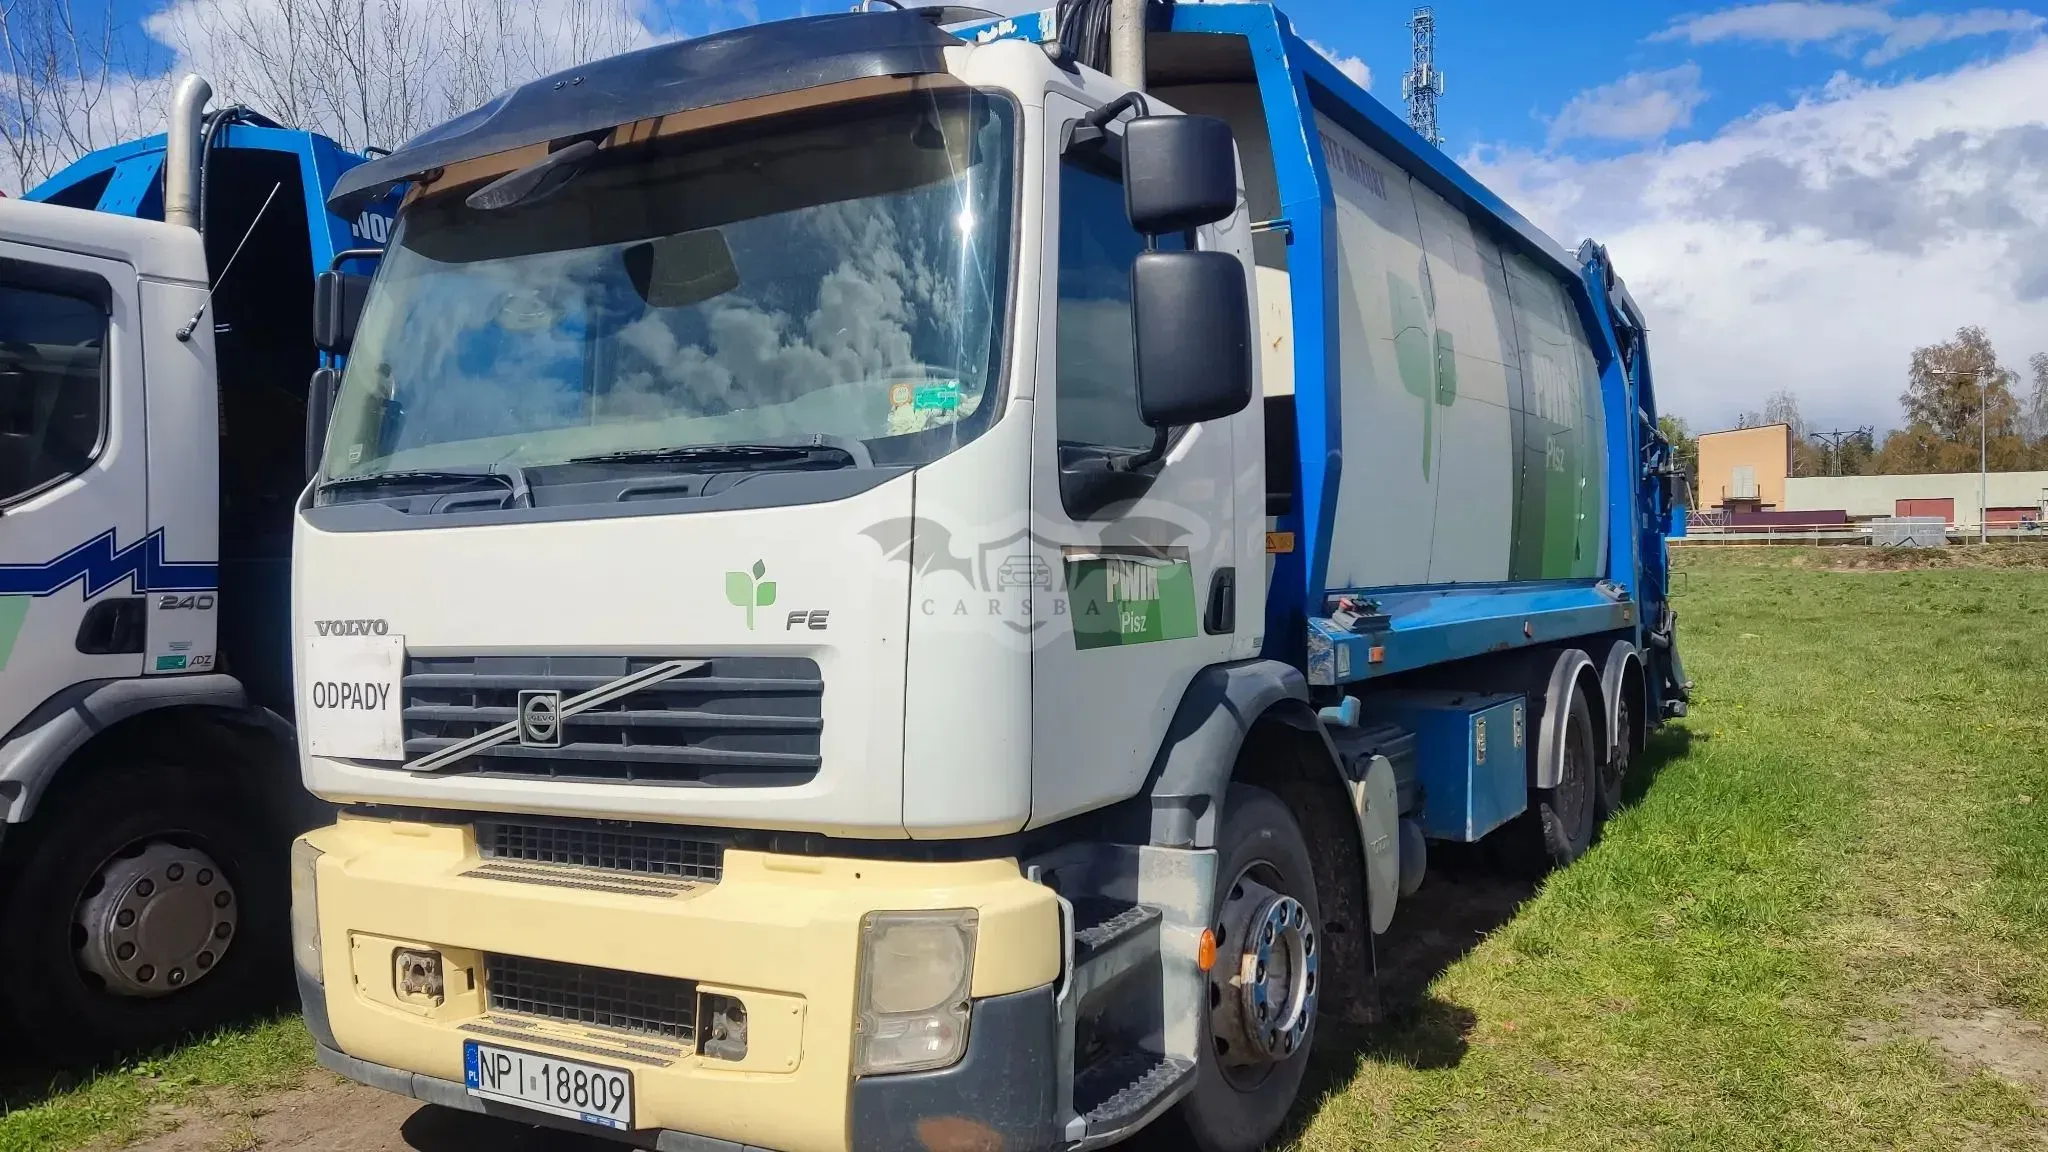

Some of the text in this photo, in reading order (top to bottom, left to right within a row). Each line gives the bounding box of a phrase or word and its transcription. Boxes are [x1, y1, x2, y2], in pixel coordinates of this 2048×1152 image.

[1546, 436, 1565, 473] Pisz
[159, 595, 214, 610] 240
[314, 619, 389, 636] VOLVO
[786, 610, 829, 630] FE
[1121, 610, 1147, 634] Pisz
[313, 681, 391, 710] ODPADY
[525, 714, 555, 722] VOLVO
[468, 1070, 478, 1082] PL
[480, 1051, 625, 1114] NPI 18809
